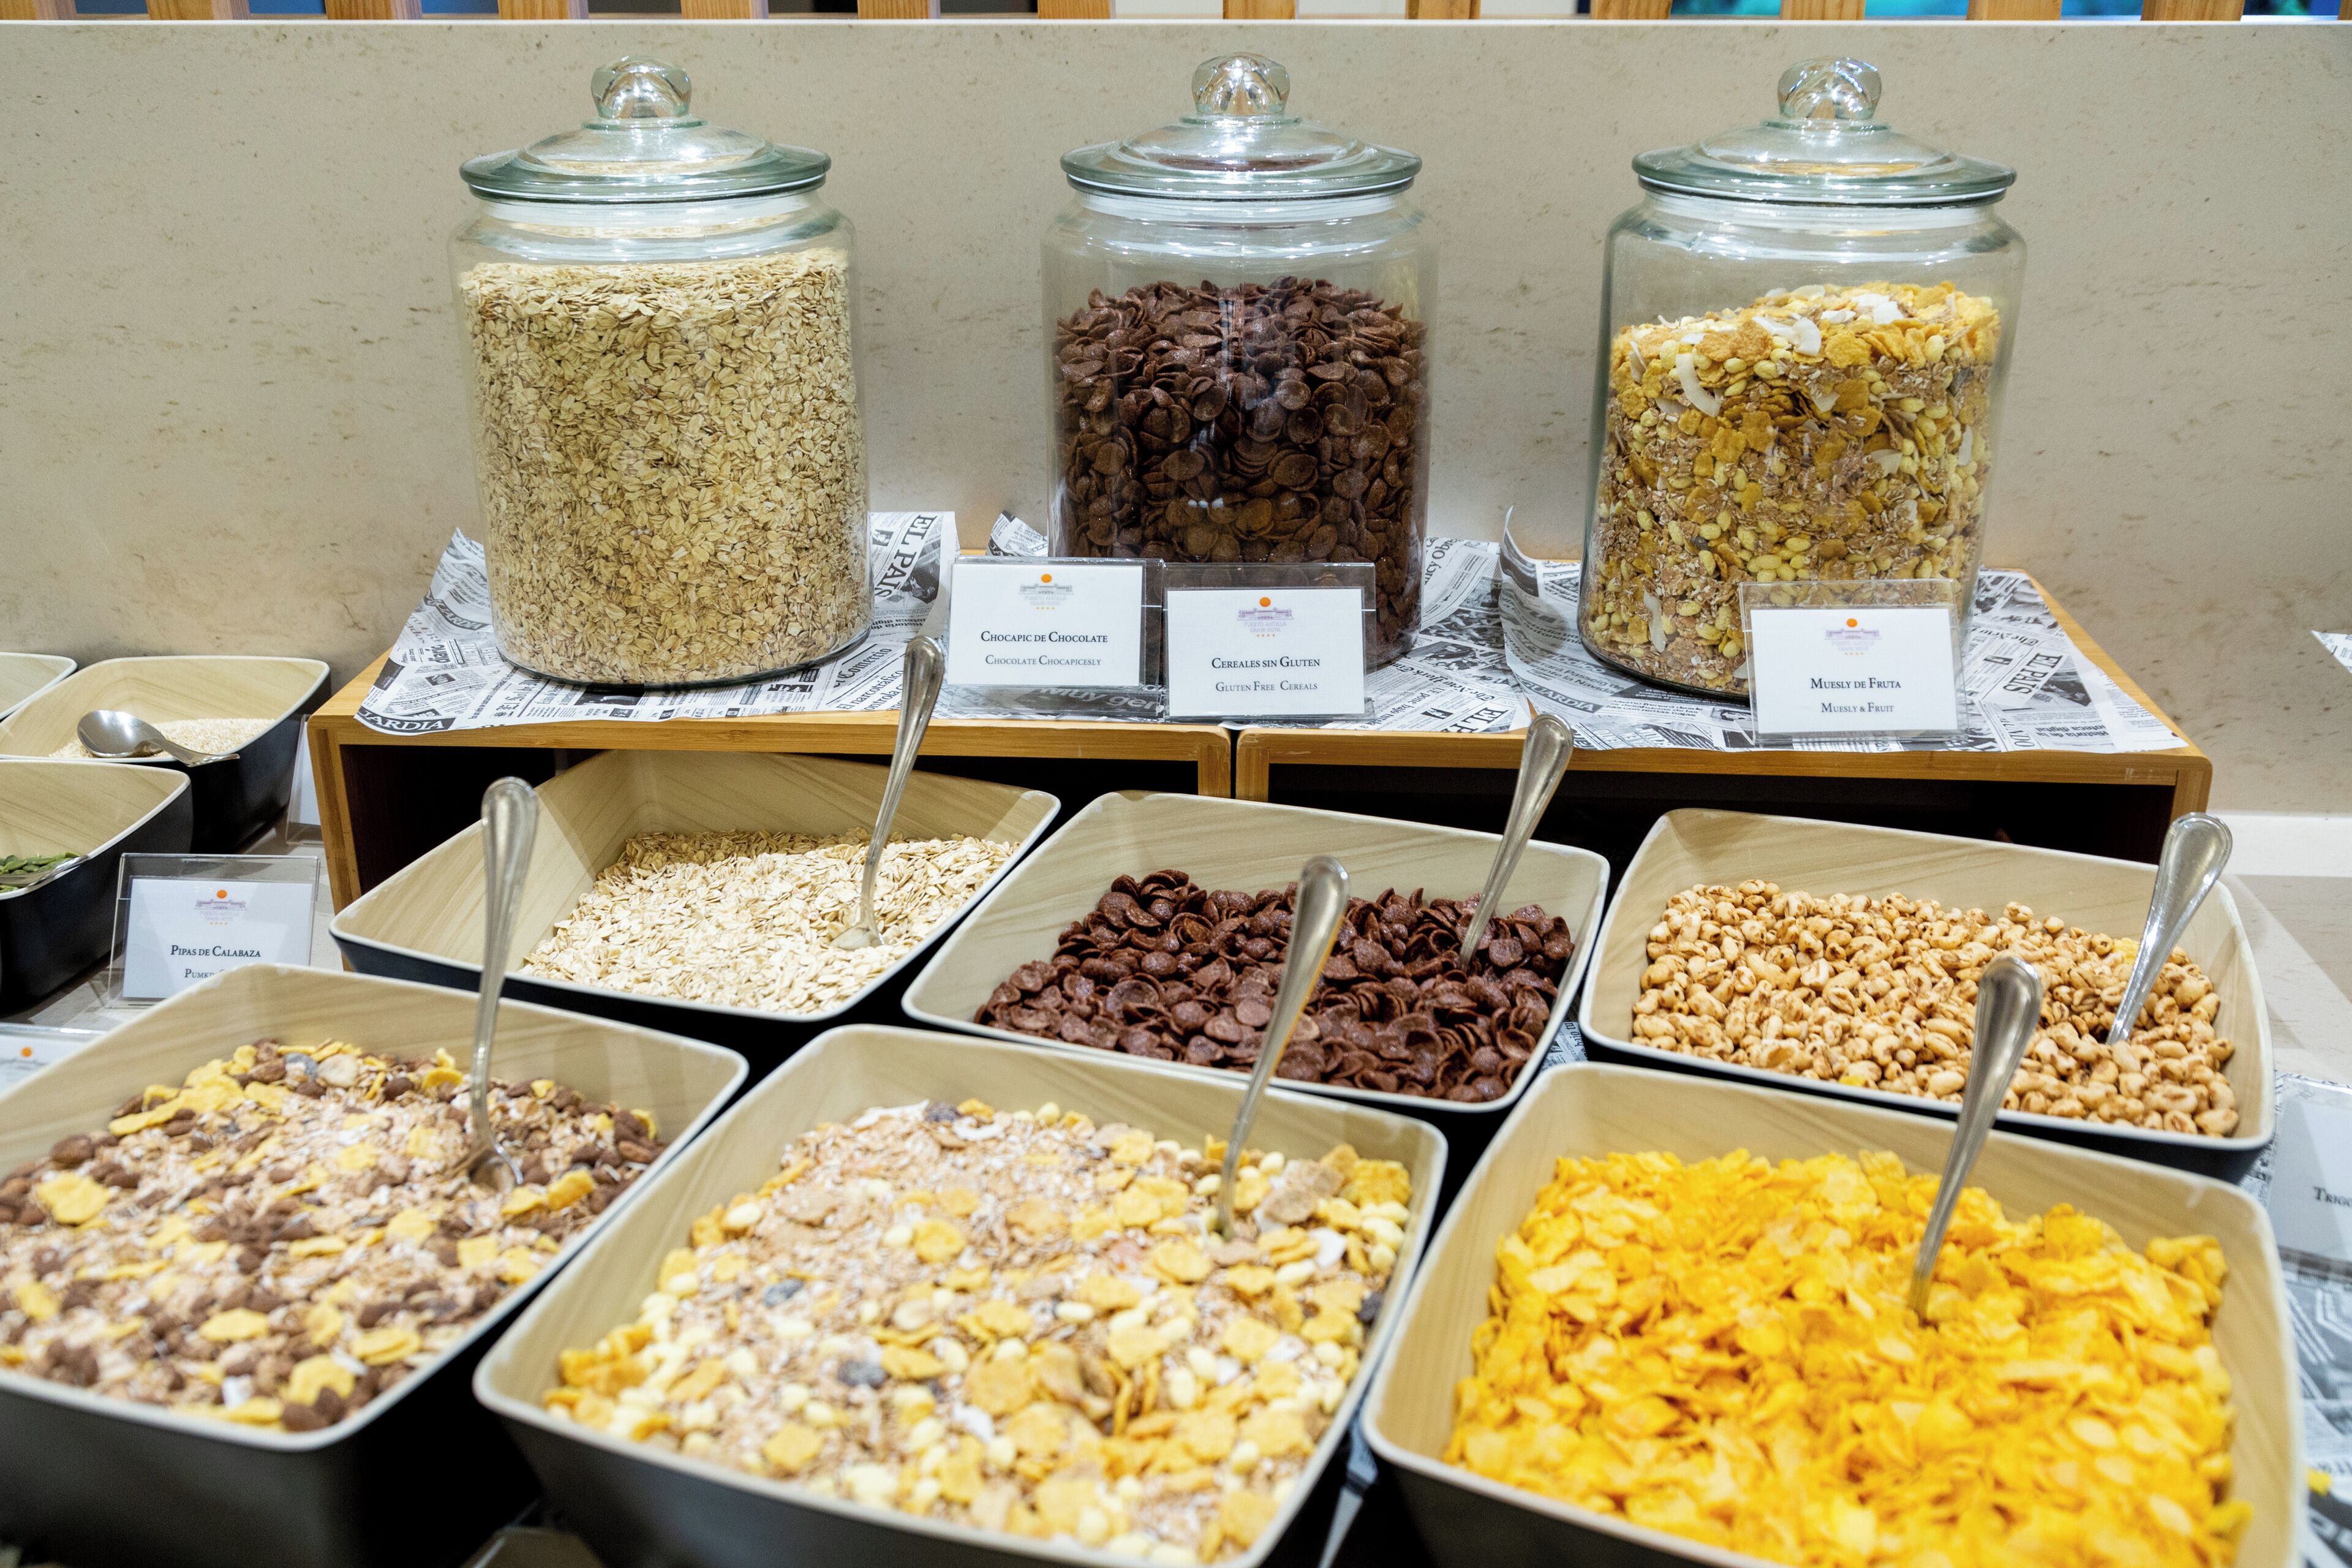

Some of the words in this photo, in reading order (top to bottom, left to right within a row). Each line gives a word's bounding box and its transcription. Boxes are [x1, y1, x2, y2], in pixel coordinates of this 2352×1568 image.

[900, 514, 937, 545] EL
[981, 631, 1032, 643] CHOCAPIC
[1048, 631, 1108, 643] CHOCOLATE
[837, 648, 892, 679] Comercio
[985, 655, 1037, 666] CHOCOLATE
[1039, 655, 1101, 666] CHOCAPICESLY
[1212, 657, 1261, 669] CEREALES
[1280, 656, 1321, 668] GLUTEN
[2026, 653, 2063, 668] EL
[850, 670, 904, 704] narcotráfico
[1215, 681, 1251, 692] GLUTEN
[1253, 681, 1275, 692] FREE
[1280, 680, 1317, 691] CEREALS
[1811, 678, 1852, 689] MUESLY
[1868, 677, 1901, 688] FRUTA
[861, 690, 898, 710] ontrola
[1821, 703, 1857, 713] MUESLY
[1868, 703, 1894, 712] FRUIT
[170, 944, 197, 956] PIPAS
[212, 946, 261, 957] CALABAZA
[184, 968, 215, 979] PUMK
